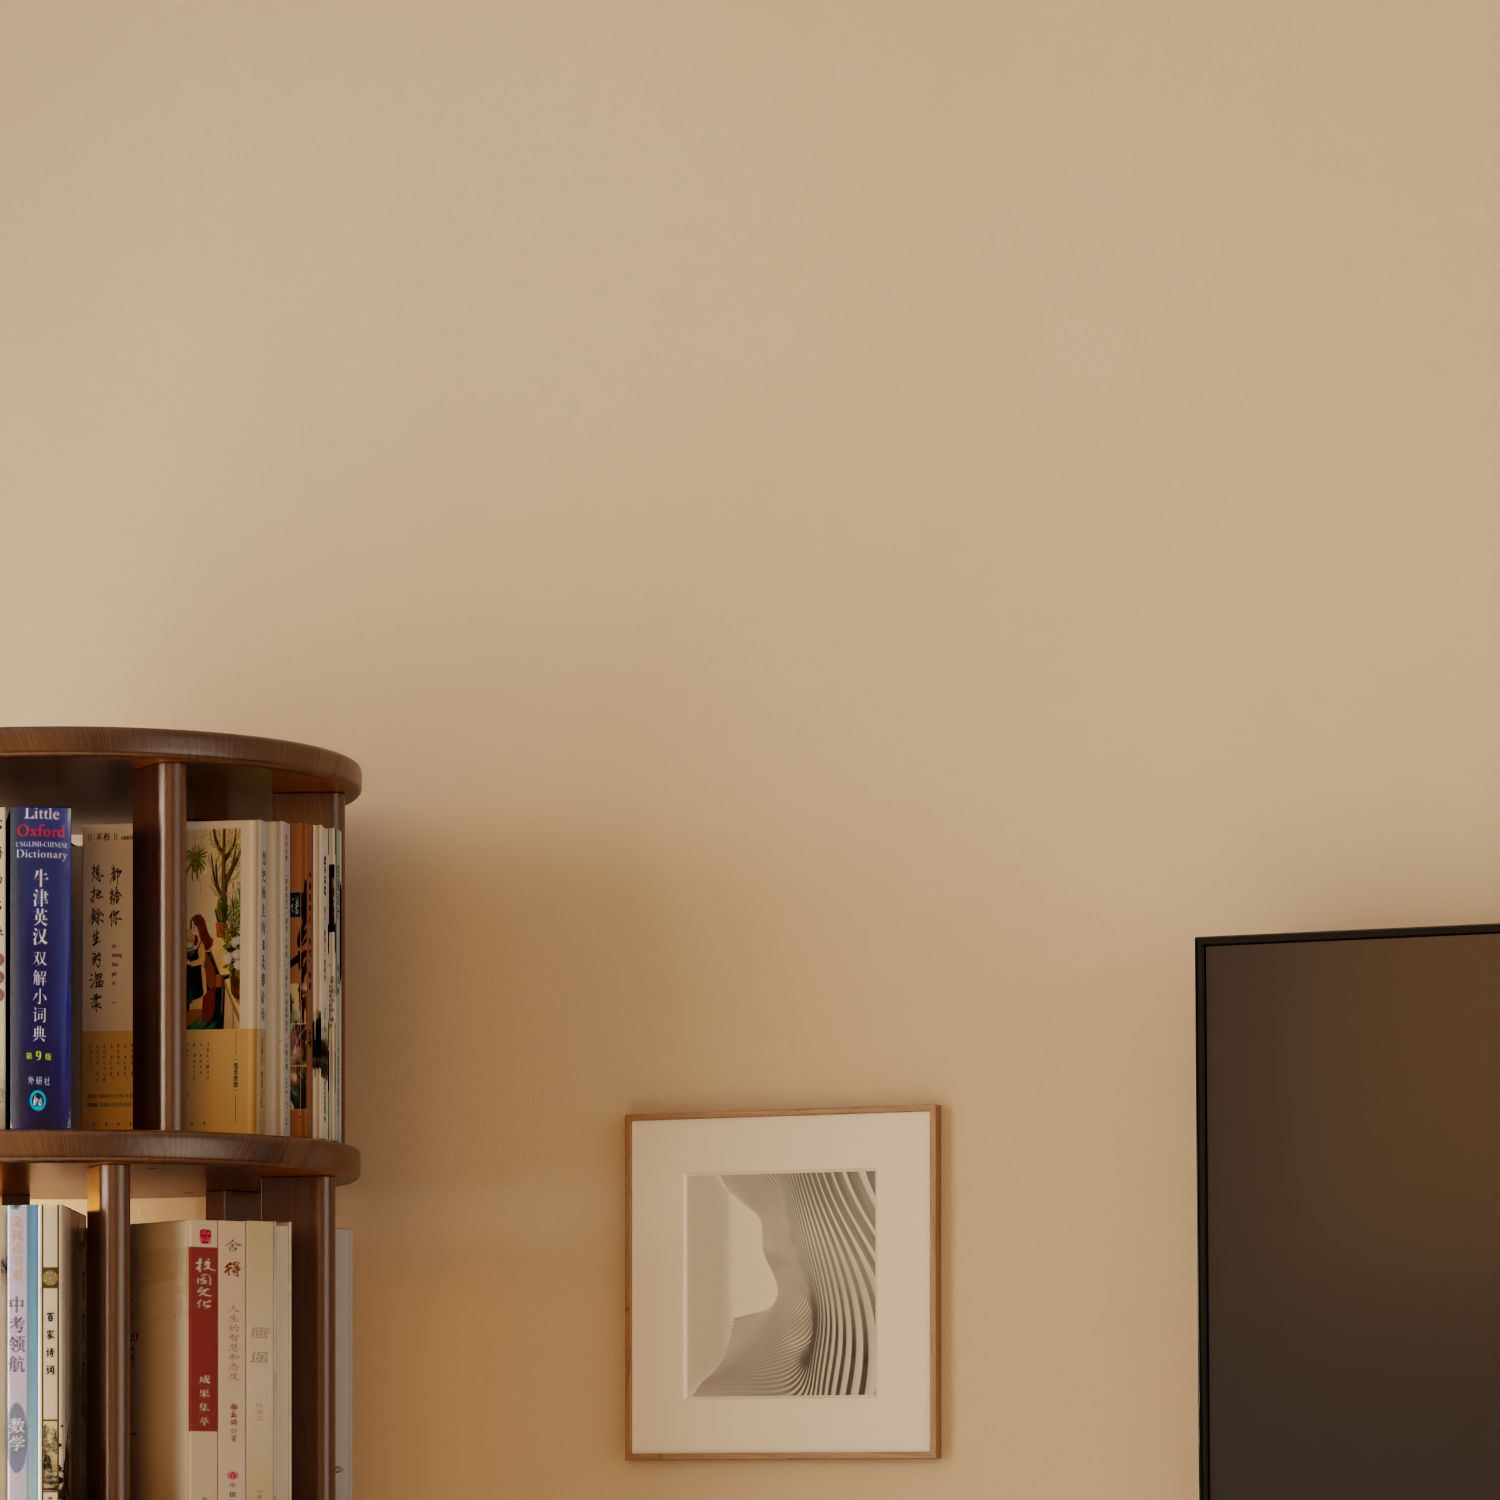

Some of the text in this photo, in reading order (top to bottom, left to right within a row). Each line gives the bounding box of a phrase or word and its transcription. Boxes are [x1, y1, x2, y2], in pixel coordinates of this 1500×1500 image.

[17, 824, 66, 839] Oxford
[24, 808, 60, 820] Little
[16, 841, 69, 849] ENGLISH-CHINESE
[16, 848, 68, 862] Dictionary
[27, 1076, 51, 1086] 外研社
[224, 1239, 243, 1278] 舍得
[195, 1257, 217, 1310] 校园文化
[9, 1296, 26, 1373] 中考领航
[46, 1312, 55, 1375] 百家诗词
[228, 1304, 240, 1382] 人生的智慧和态度
[199, 1374, 211, 1427] 成果集萃
[9, 1417, 26, 1452] 数学
